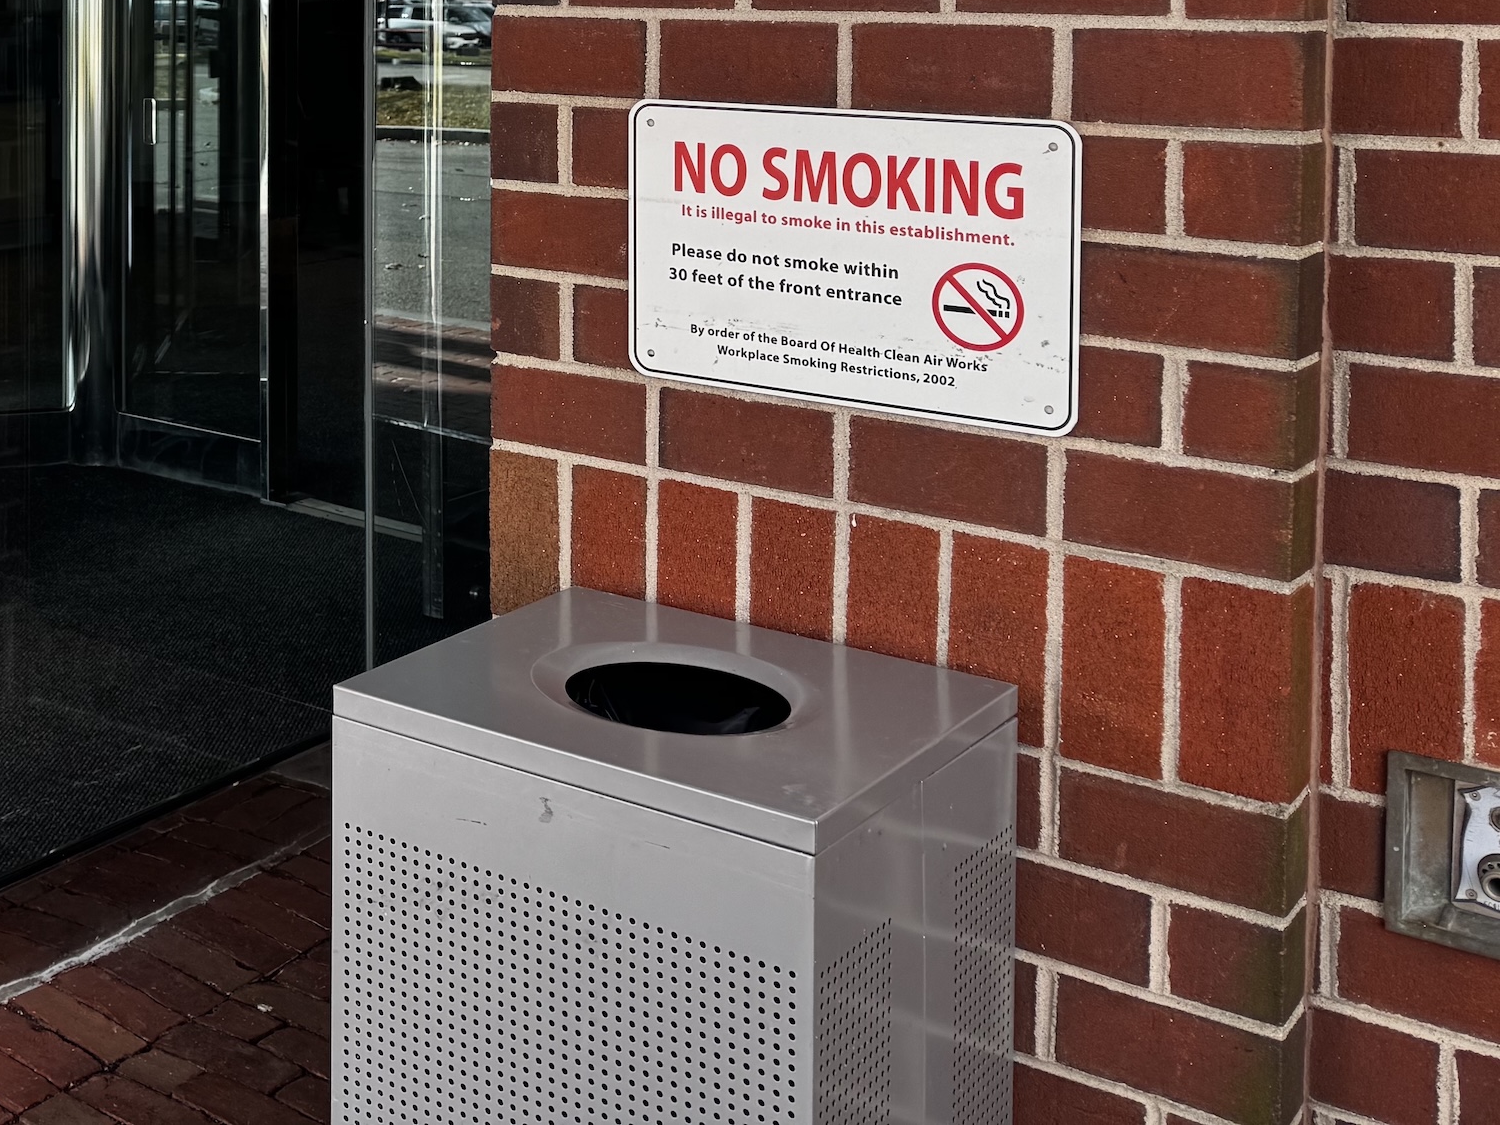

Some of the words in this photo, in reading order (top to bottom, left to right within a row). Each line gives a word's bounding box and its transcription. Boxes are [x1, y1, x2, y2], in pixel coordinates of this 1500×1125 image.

[675, 141, 747, 196] NO
[762, 147, 1023, 220] SMOKING
[681, 204, 692, 217] It
[696, 205, 708, 218] is
[711, 206, 757, 225] illegal
[761, 212, 777, 225] to
[781, 215, 832, 230] smoke
[836, 217, 851, 232] in
[855, 219, 885, 235] this
[889, 225, 1015, 247] establishment.
[672, 242, 722, 261] Please
[726, 248, 747, 263] do
[752, 254, 780, 267] not
[784, 257, 839, 273] smoke
[843, 261, 899, 280] within
[669, 267, 688, 281] 30
[691, 268, 723, 286] feet
[727, 273, 745, 288] of
[747, 275, 775, 292] the
[778, 278, 822, 297] front
[825, 287, 902, 306] entrance
[690, 323, 705, 337] By
[707, 327, 740, 340] order
[742, 331, 756, 342] of
[757, 332, 778, 345] the
[781, 335, 817, 350] Board
[820, 341, 836, 353] Of
[838, 343, 881, 359] Health
[883, 349, 920, 364] Clean
[923, 354, 943, 367] Air
[945, 354, 989, 372] Works
[717, 344, 780, 363] Workplace
[782, 353, 837, 373] Smoking
[840, 361, 920, 384] Restrictions,
[922, 373, 955, 387] 2002
